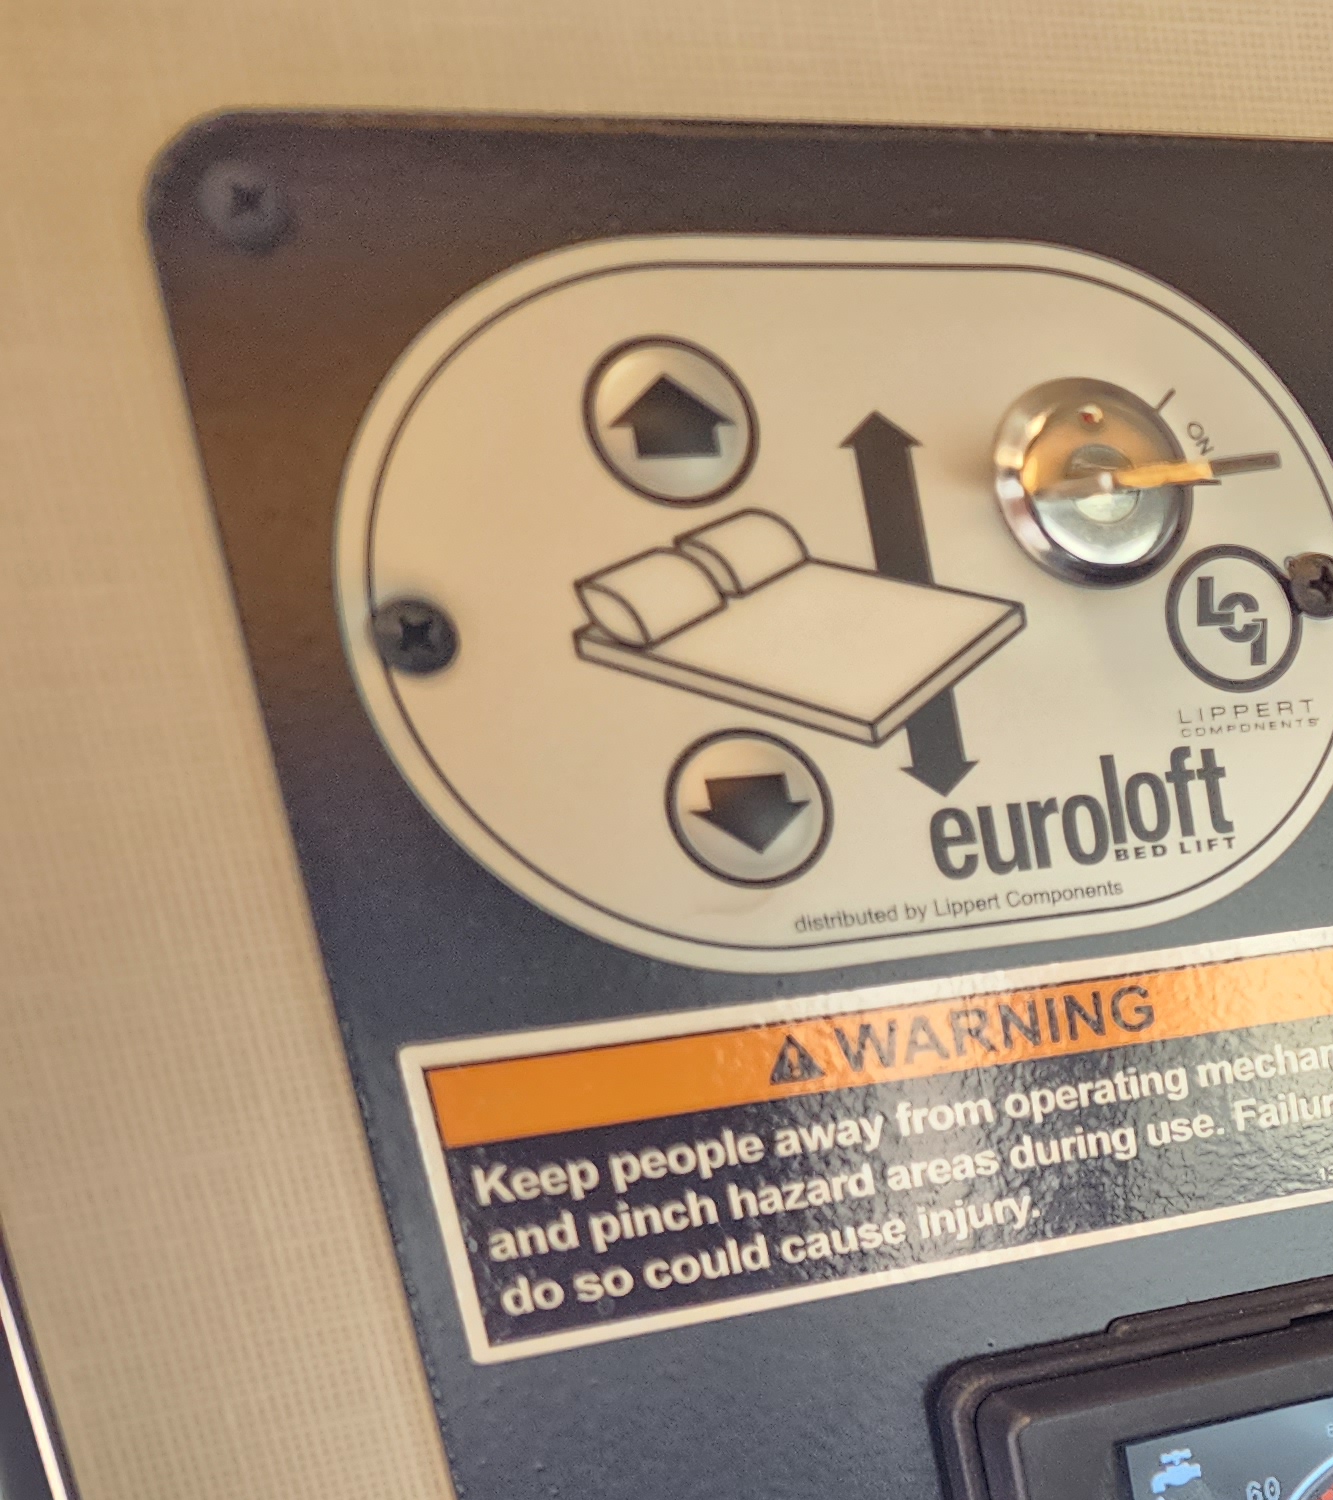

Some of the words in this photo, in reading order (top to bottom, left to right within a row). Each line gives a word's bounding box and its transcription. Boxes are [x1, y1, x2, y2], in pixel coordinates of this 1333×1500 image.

[1186, 421, 1214, 456] ON
[1178, 699, 1316, 725] LIPPERT
[1180, 717, 1320, 738] COMPONENTS
[929, 745, 1235, 881] euroloft
[1114, 844, 1168, 862] BED
[1179, 836, 1237, 855] LIFT
[794, 904, 898, 934] distributed
[904, 902, 928, 923] by
[934, 894, 1001, 919] Lippert
[1006, 880, 1124, 908] Components
[834, 984, 1156, 1073] WARNING
[471, 1160, 599, 1207] Keep
[608, 1128, 765, 1192] people
[772, 1112, 885, 1156] away
[896, 1098, 993, 1137] from
[1004, 1064, 1190, 1123] operating
[487, 1210, 580, 1262] and
[589, 1191, 720, 1253] pinch
[728, 1163, 875, 1220] hazard
[886, 1147, 999, 1192] areas
[1009, 1125, 1139, 1171] during
[1147, 1115, 1225, 1148] use.
[501, 1277, 565, 1317] do
[575, 1265, 635, 1304] so
[643, 1236, 772, 1288] could
[780, 1214, 908, 1265] cause
[918, 1193, 1042, 1241] injury.
